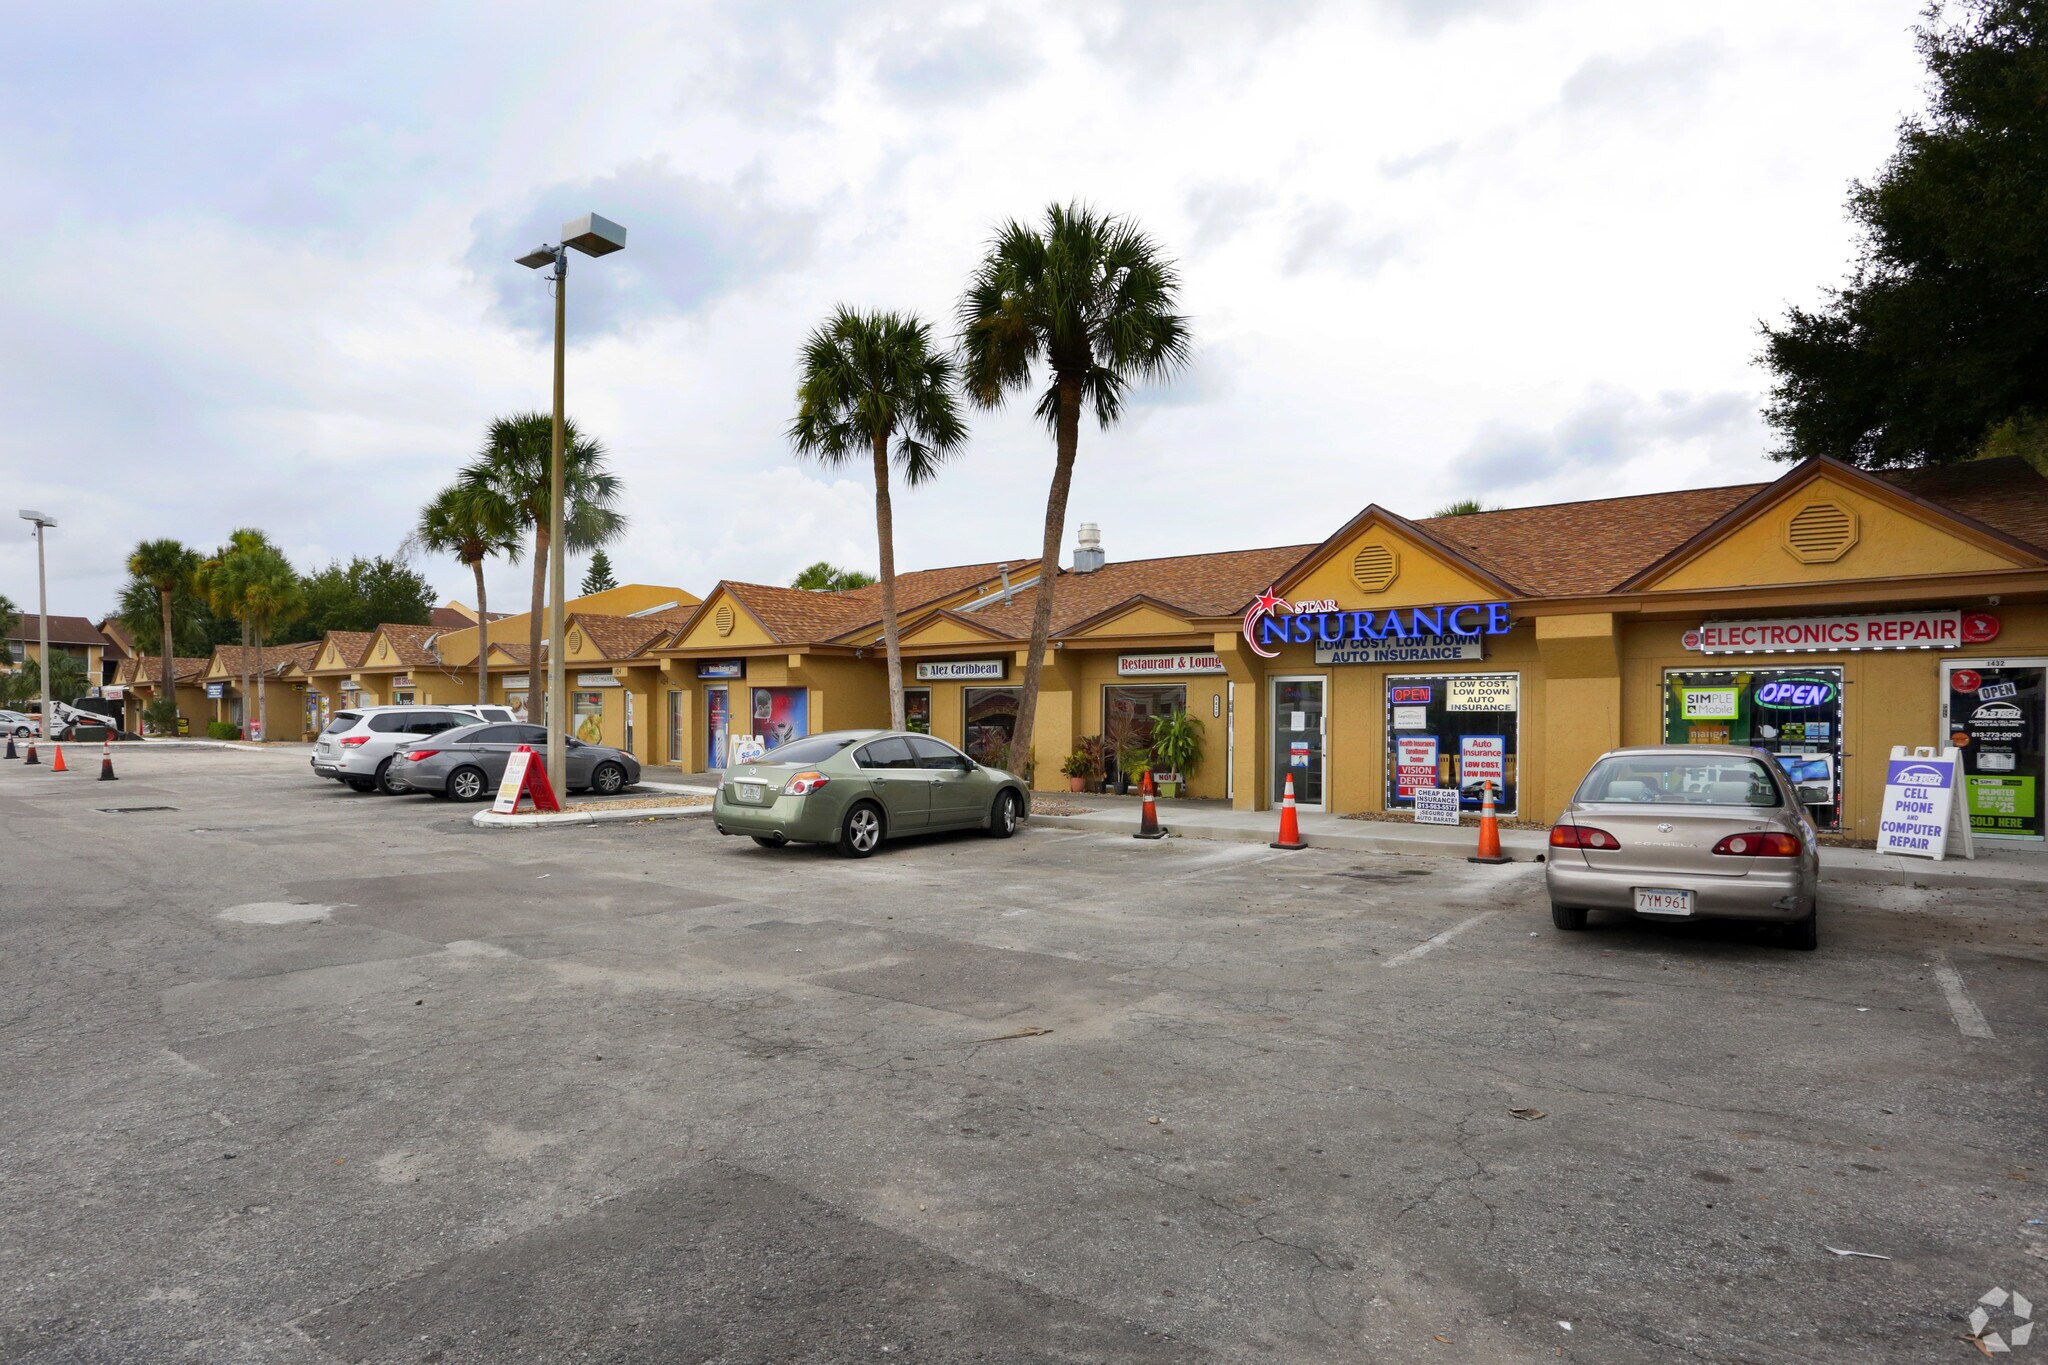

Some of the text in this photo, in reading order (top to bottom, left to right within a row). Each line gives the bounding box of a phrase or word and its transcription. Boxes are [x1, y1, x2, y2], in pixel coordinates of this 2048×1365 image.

[1294, 600, 1339, 614] STAR
[1705, 623, 1860, 646] ELECTRONICS
[1867, 619, 1957, 641] REPAIR
[1316, 638, 1347, 651] LOW
[1395, 634, 1430, 648] LOW
[1432, 633, 1480, 646] DOWN
[1331, 647, 1462, 663] AUTO INSURANCE
[930, 663, 998, 675] Alez Caribbean
[1121, 656, 1222, 670] Restaurant & Loung
[1394, 688, 1429, 701] OPEN
[1760, 683, 1829, 706] OPEN
[1981, 683, 2014, 699] OPEN
[1687, 694, 1733, 703] SIMPLE
[1698, 704, 1733, 714] Mobile
[1974, 708, 2021, 719] DreTech
[1472, 739, 1492, 748] Auto
[1463, 749, 1502, 757] Insurance
[1401, 766, 1432, 774] VISION
[1400, 776, 1434, 785] DENTAL
[1904, 787, 1928, 799] CELL
[1895, 801, 1934, 814] PHONE
[1970, 816, 2023, 827] SOLD HERE
[1881, 821, 1942, 837] COMPUTER
[1889, 835, 1930, 850] REPAIR
[1639, 894, 1687, 909] 7YM 961
